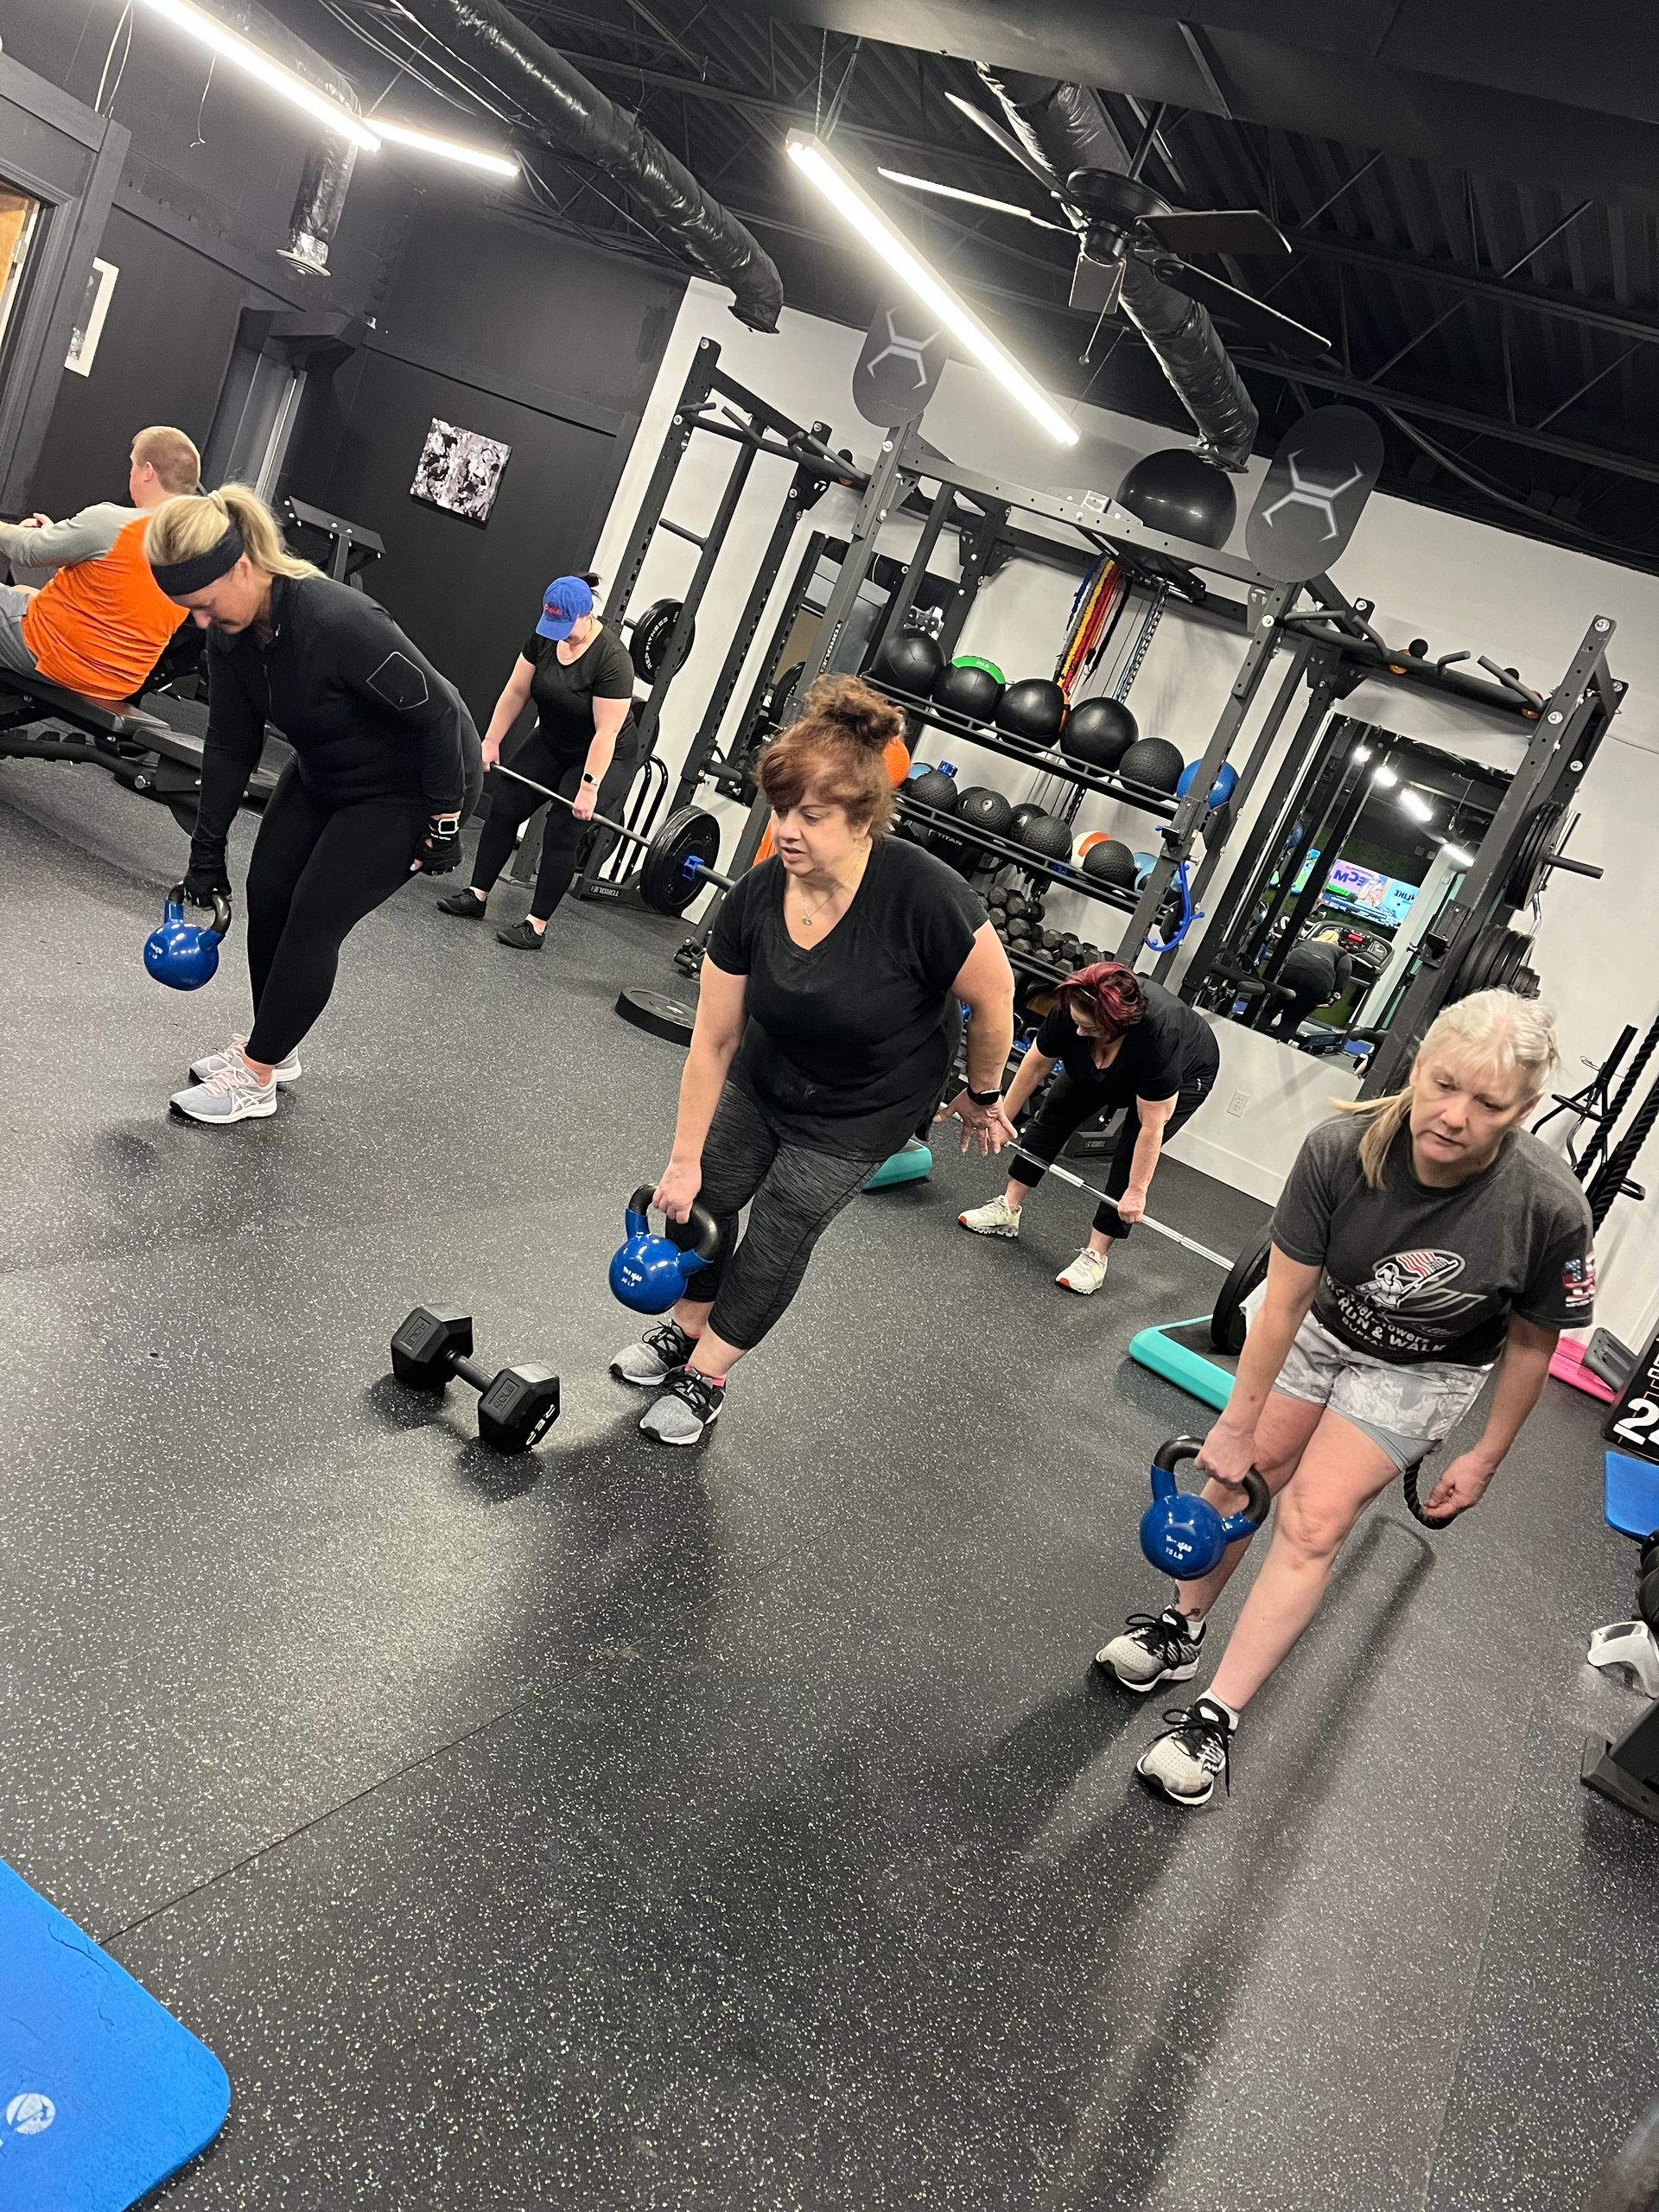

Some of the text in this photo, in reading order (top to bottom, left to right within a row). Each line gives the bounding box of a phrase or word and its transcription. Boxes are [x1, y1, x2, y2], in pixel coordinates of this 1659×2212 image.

[645, 616, 669, 651] FITNESS
[938, 832, 963, 846] TITAN
[1338, 1297, 1447, 1351] RUN & WALK
[1342, 1316, 1396, 1350] BUFFA
[1612, 1397, 1659, 1446] 2
